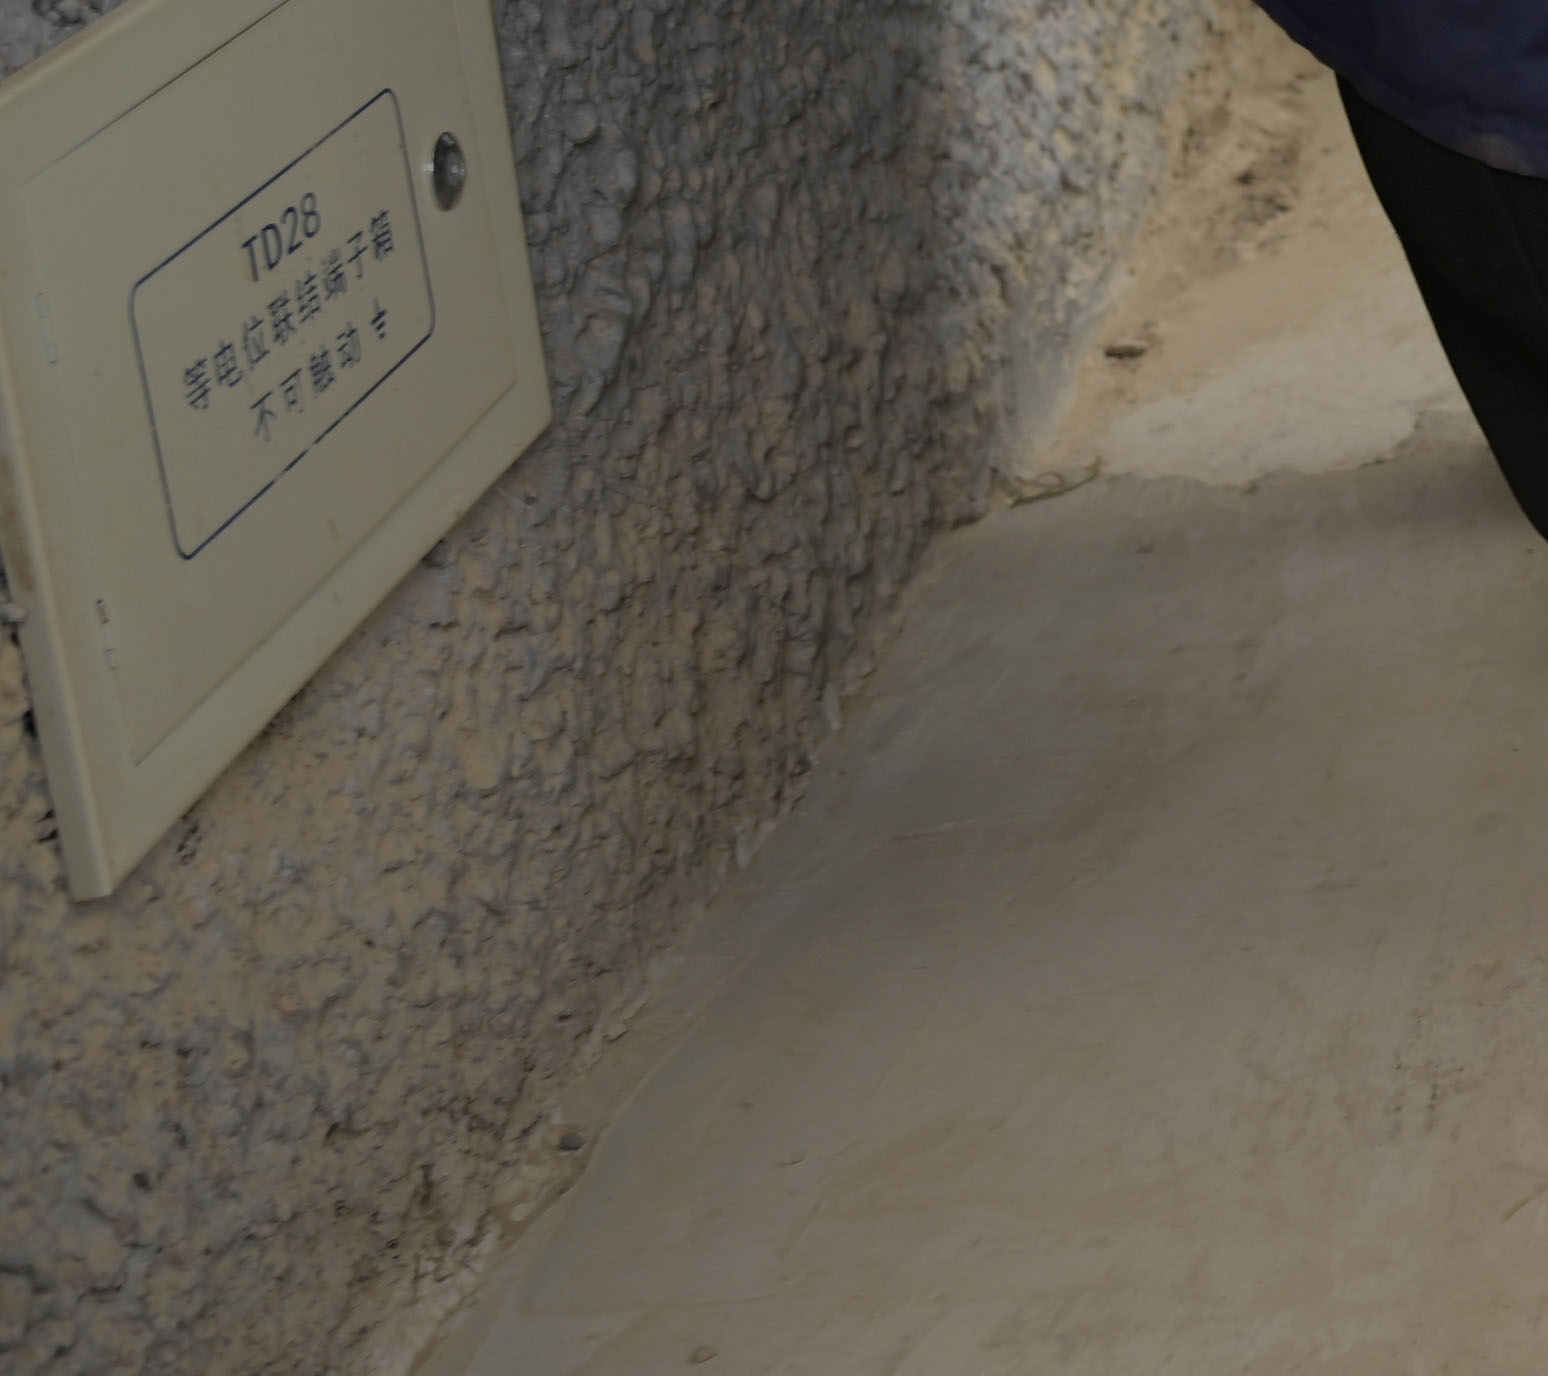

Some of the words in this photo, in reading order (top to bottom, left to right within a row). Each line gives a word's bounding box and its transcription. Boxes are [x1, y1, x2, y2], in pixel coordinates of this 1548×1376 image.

[241, 191, 321, 283] TD28
[184, 209, 395, 411] 等电位联结端子箱
[251, 322, 362, 443] 不可触动
